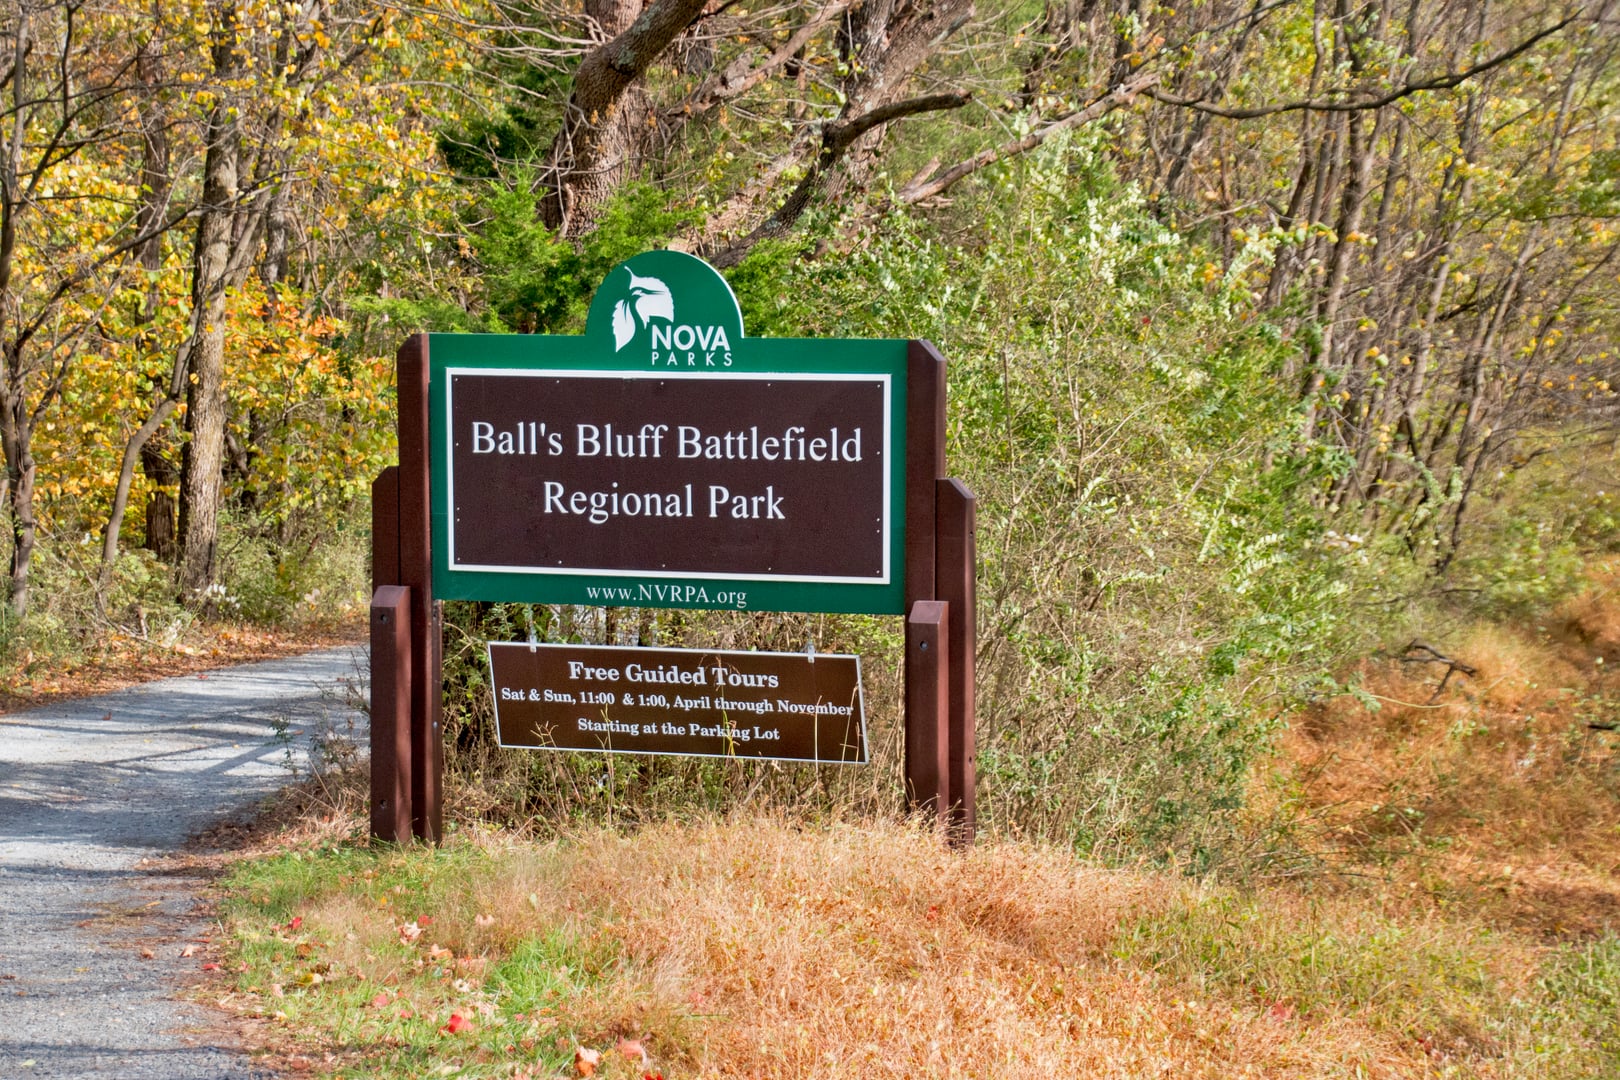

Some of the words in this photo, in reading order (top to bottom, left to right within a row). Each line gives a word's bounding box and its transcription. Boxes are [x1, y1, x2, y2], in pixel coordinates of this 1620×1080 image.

[651, 324, 731, 351] NOVA
[651, 351, 733, 367] PARKS
[471, 420, 564, 457] Ball's
[576, 423, 669, 458] Bluff
[677, 425, 863, 462] Battlefield
[543, 480, 694, 524] Regional
[708, 485, 786, 520] Park
[586, 583, 748, 609] www.NVRPA.org
[568, 660, 620, 682] Free
[625, 663, 707, 685] Guided
[712, 667, 779, 688] Tours
[501, 687, 526, 701] Sat
[529, 688, 541, 702] &
[544, 689, 577, 705] Sun,
[580, 691, 616, 705] 11:00
[622, 692, 635, 706] &
[638, 694, 671, 710] 1:00,
[673, 695, 712, 711] April
[714, 697, 775, 715] through
[777, 699, 854, 717] November
[577, 717, 640, 736] Starting
[642, 720, 659, 735] at
[661, 720, 687, 736] the
[753, 726, 781, 740] Lot
